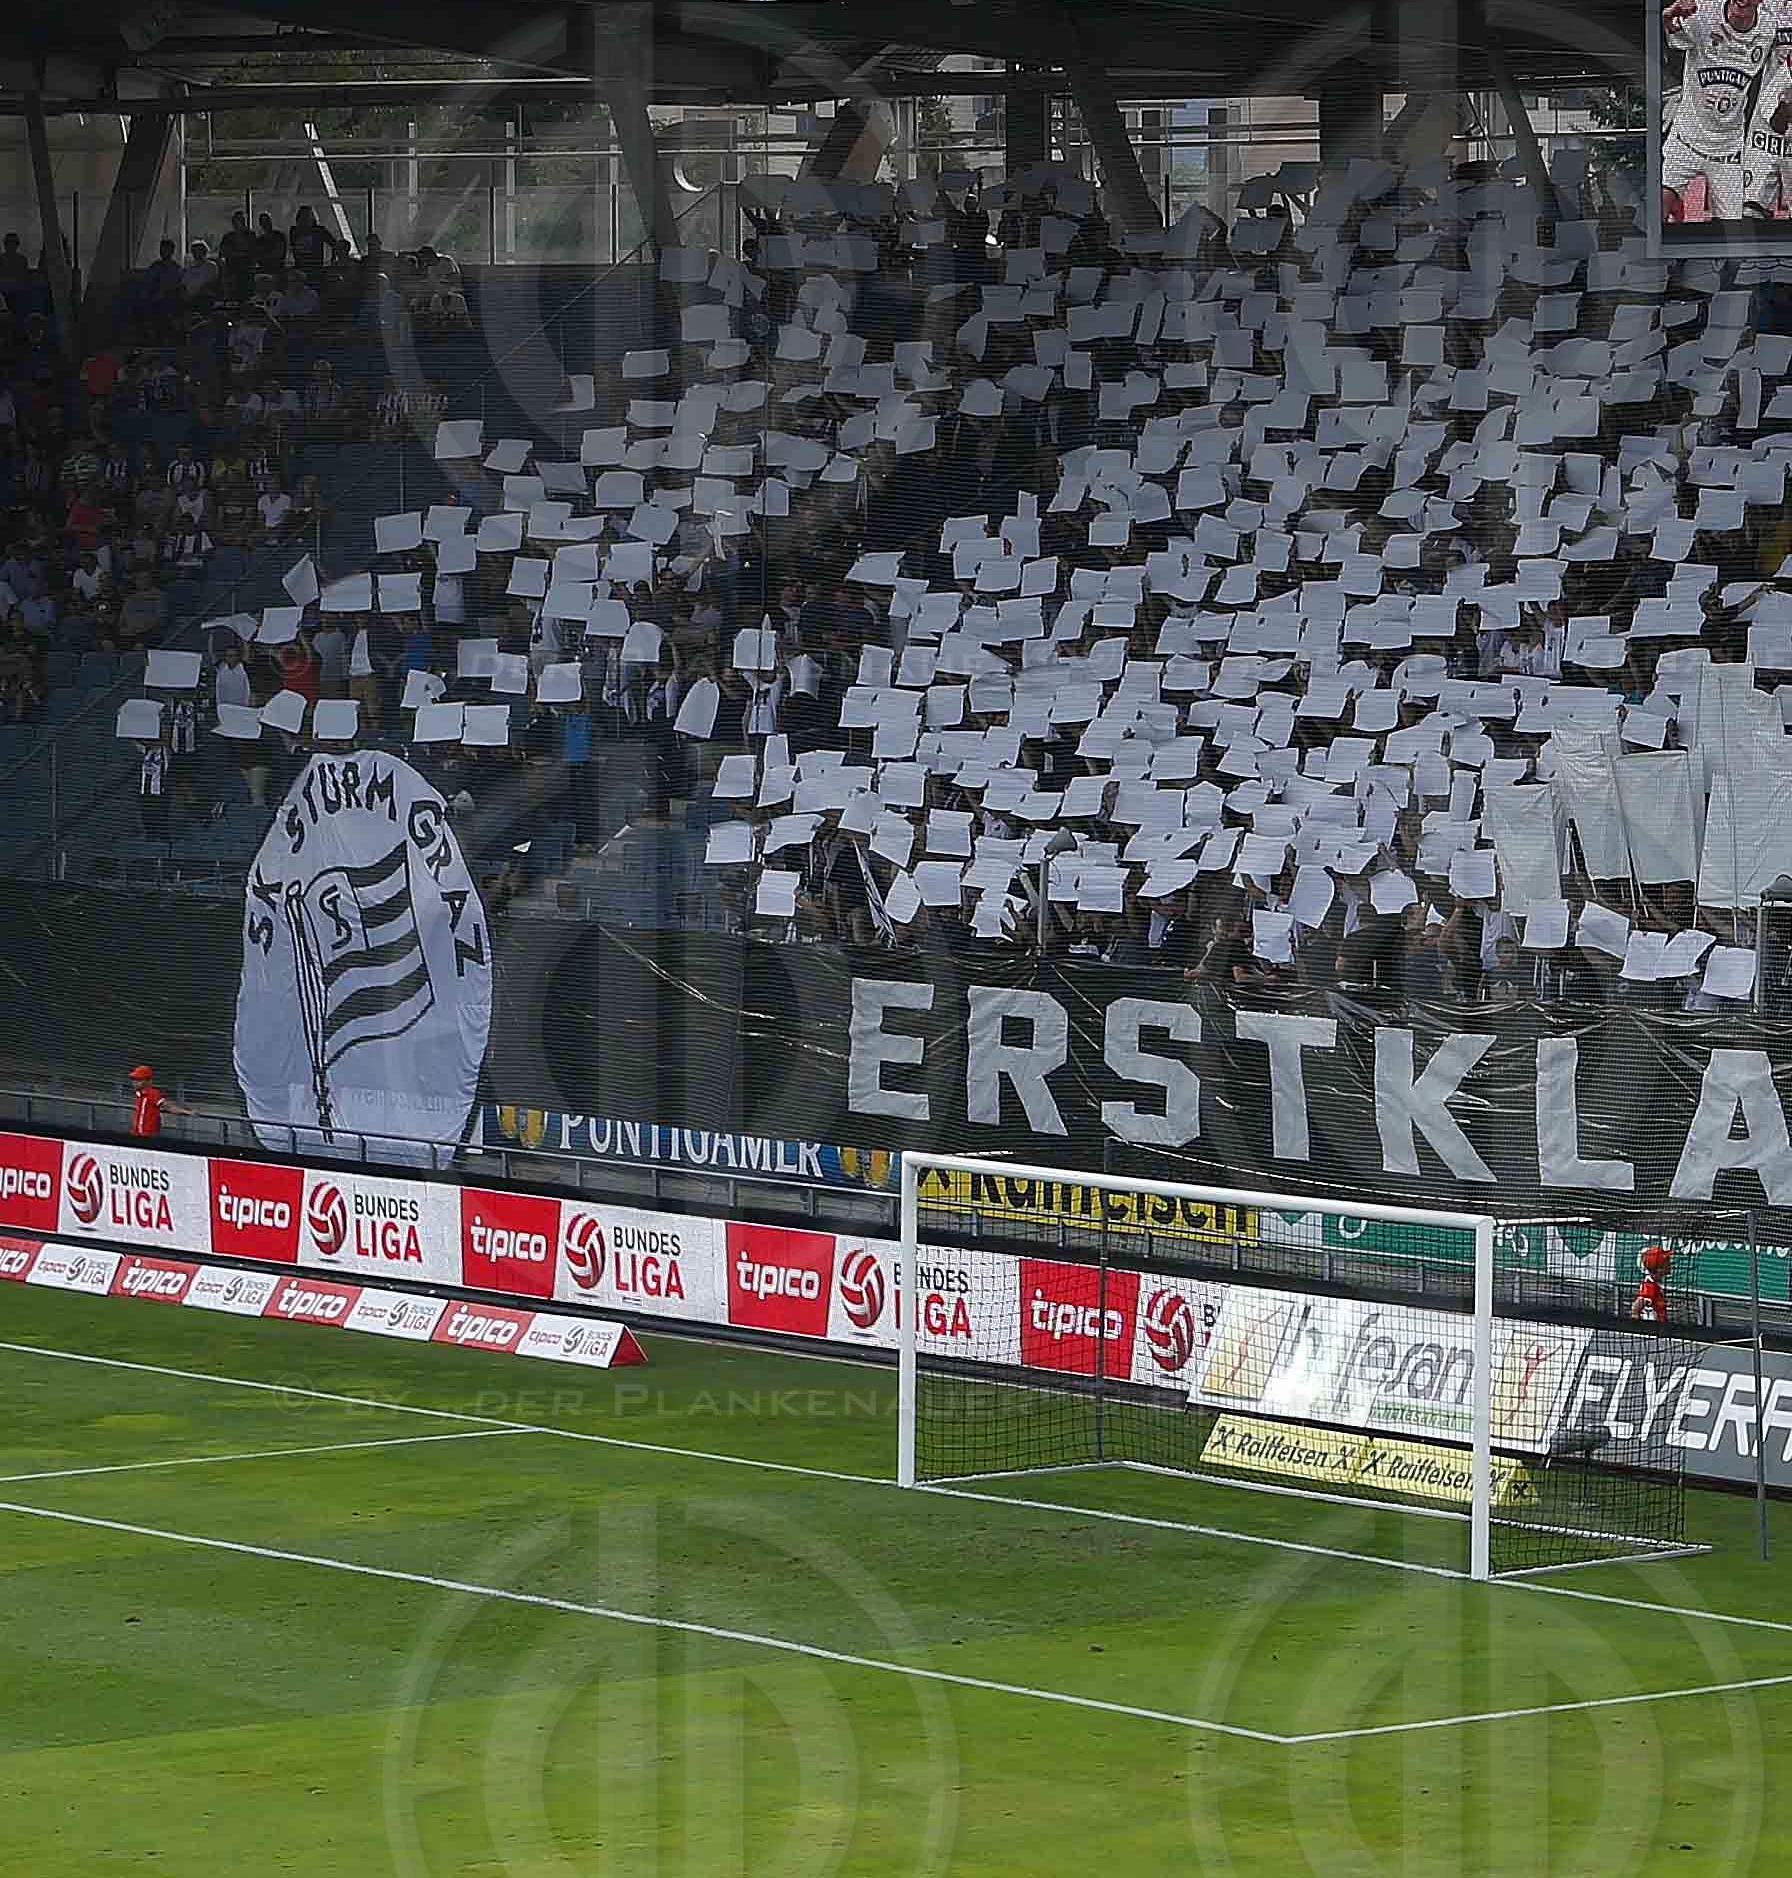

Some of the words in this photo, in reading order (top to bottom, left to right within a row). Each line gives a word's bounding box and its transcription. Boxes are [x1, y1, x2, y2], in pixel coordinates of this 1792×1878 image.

[286, 762, 397, 854] STURM
[408, 801, 485, 977] GRAZ
[110, 1164, 169, 1191] BUNDES
[111, 1189, 175, 1231] LIGA
[218, 1185, 290, 1229] tipico
[355, 1194, 419, 1221] BUNDES
[356, 1218, 423, 1262] LIGA
[471, 1216, 547, 1262] tipico
[614, 1226, 681, 1255] BUNDES
[122, 1258, 188, 1295] tipico
[615, 1252, 685, 1299] LIGA
[736, 1250, 820, 1300] tipico
[278, 1280, 348, 1319] tipico
[447, 1305, 519, 1345] tipico
[1236, 1432, 1328, 1467] Raiffeisen
